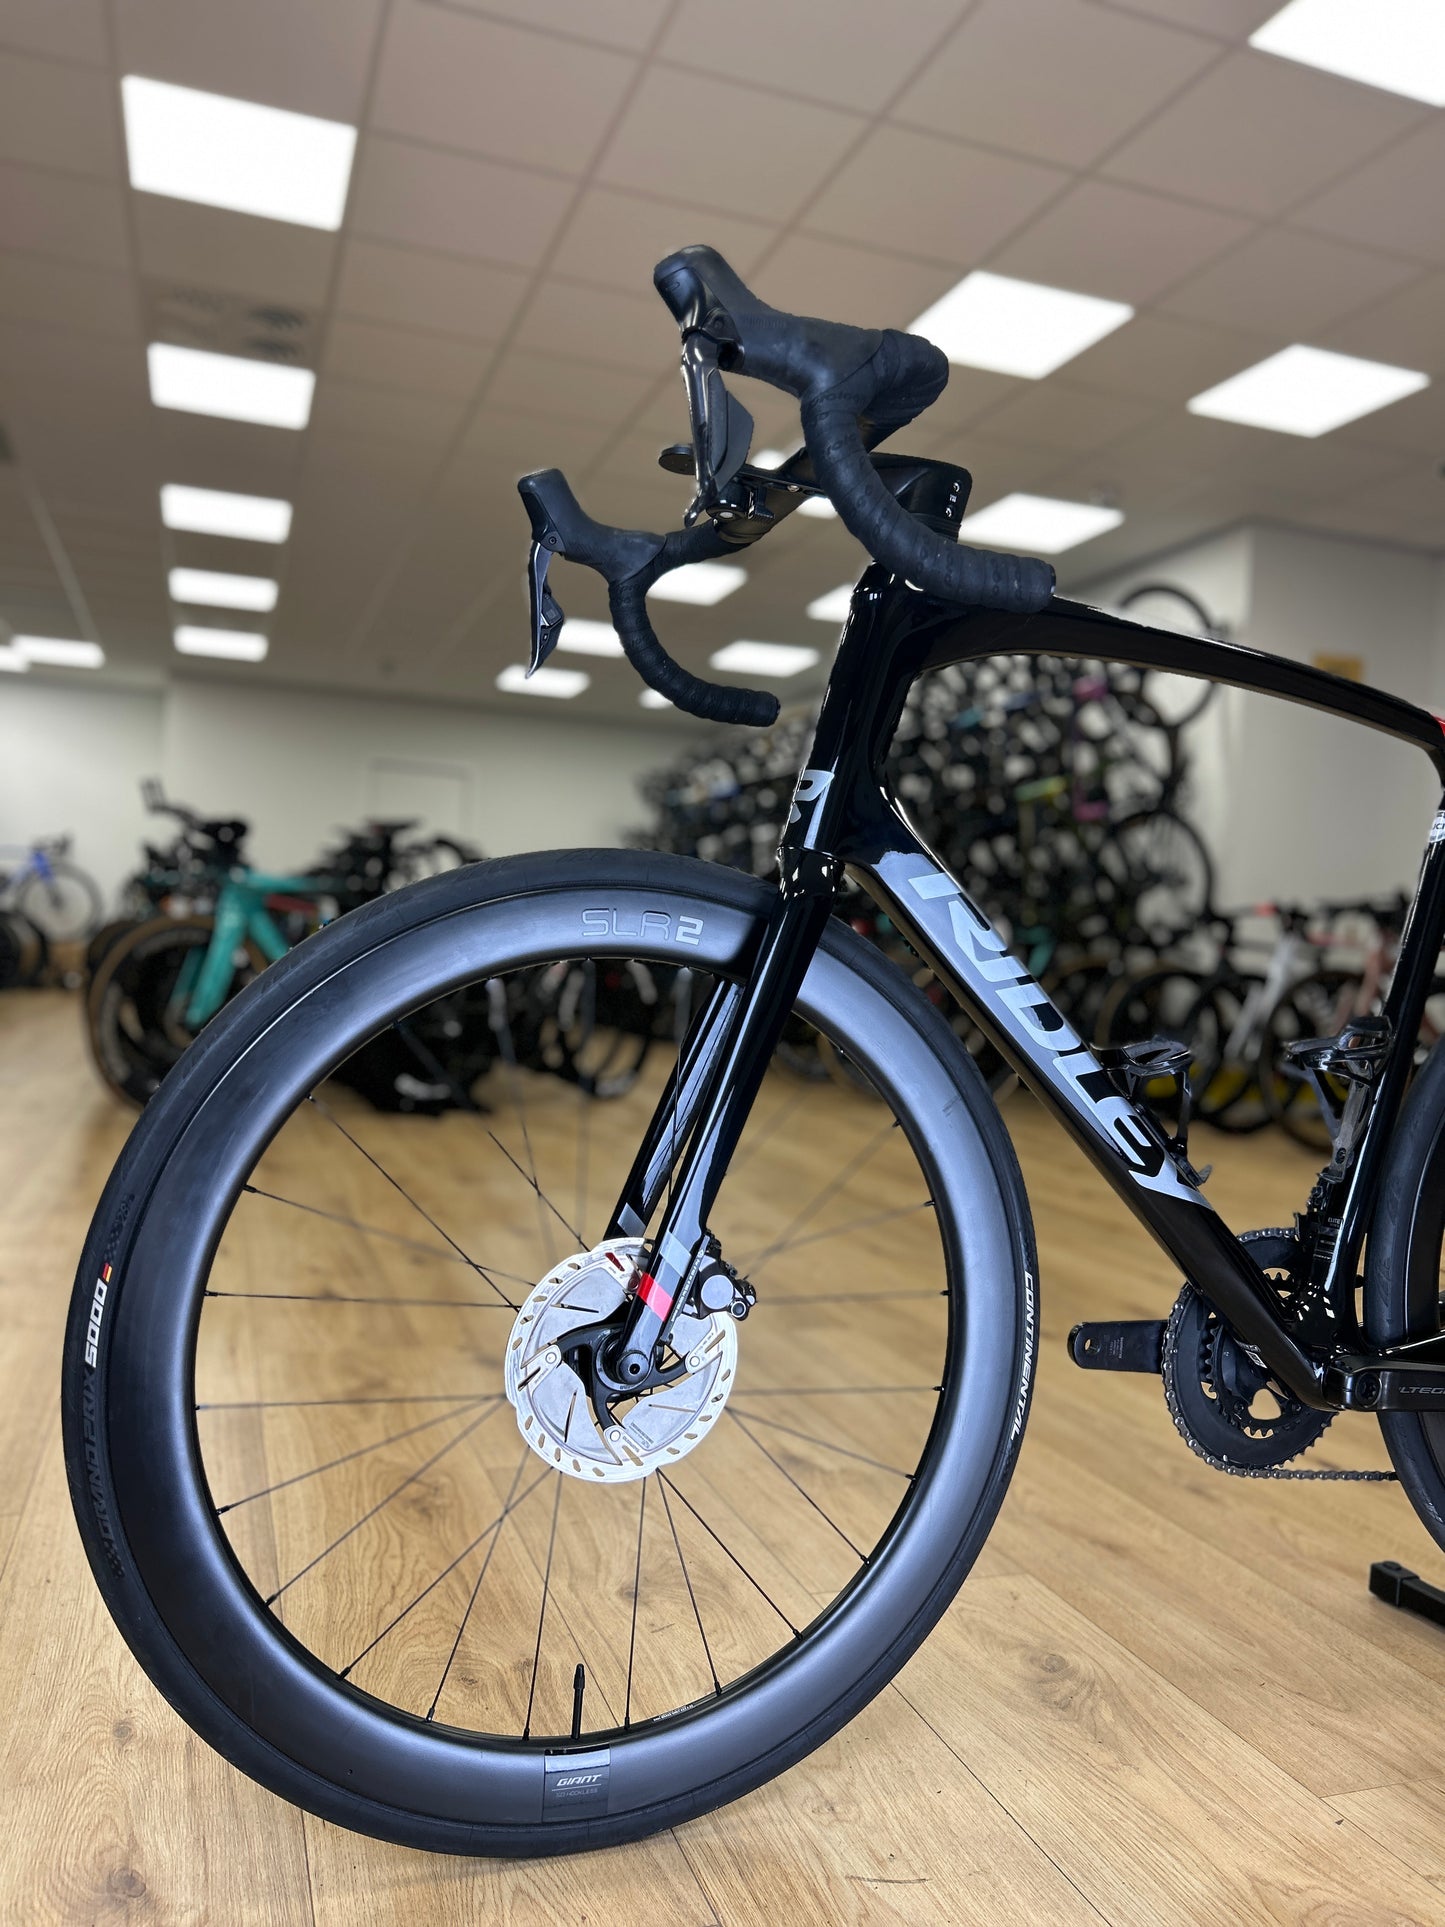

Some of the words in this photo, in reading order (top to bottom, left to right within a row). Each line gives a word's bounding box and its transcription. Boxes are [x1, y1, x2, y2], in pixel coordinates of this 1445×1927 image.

[908, 872, 1216, 1210] RIDLEY
[84, 1277, 108, 1368] 5000
[1011, 1271, 1035, 1441] CONTINENTAL
[556, 1774, 602, 1787] GIANT
